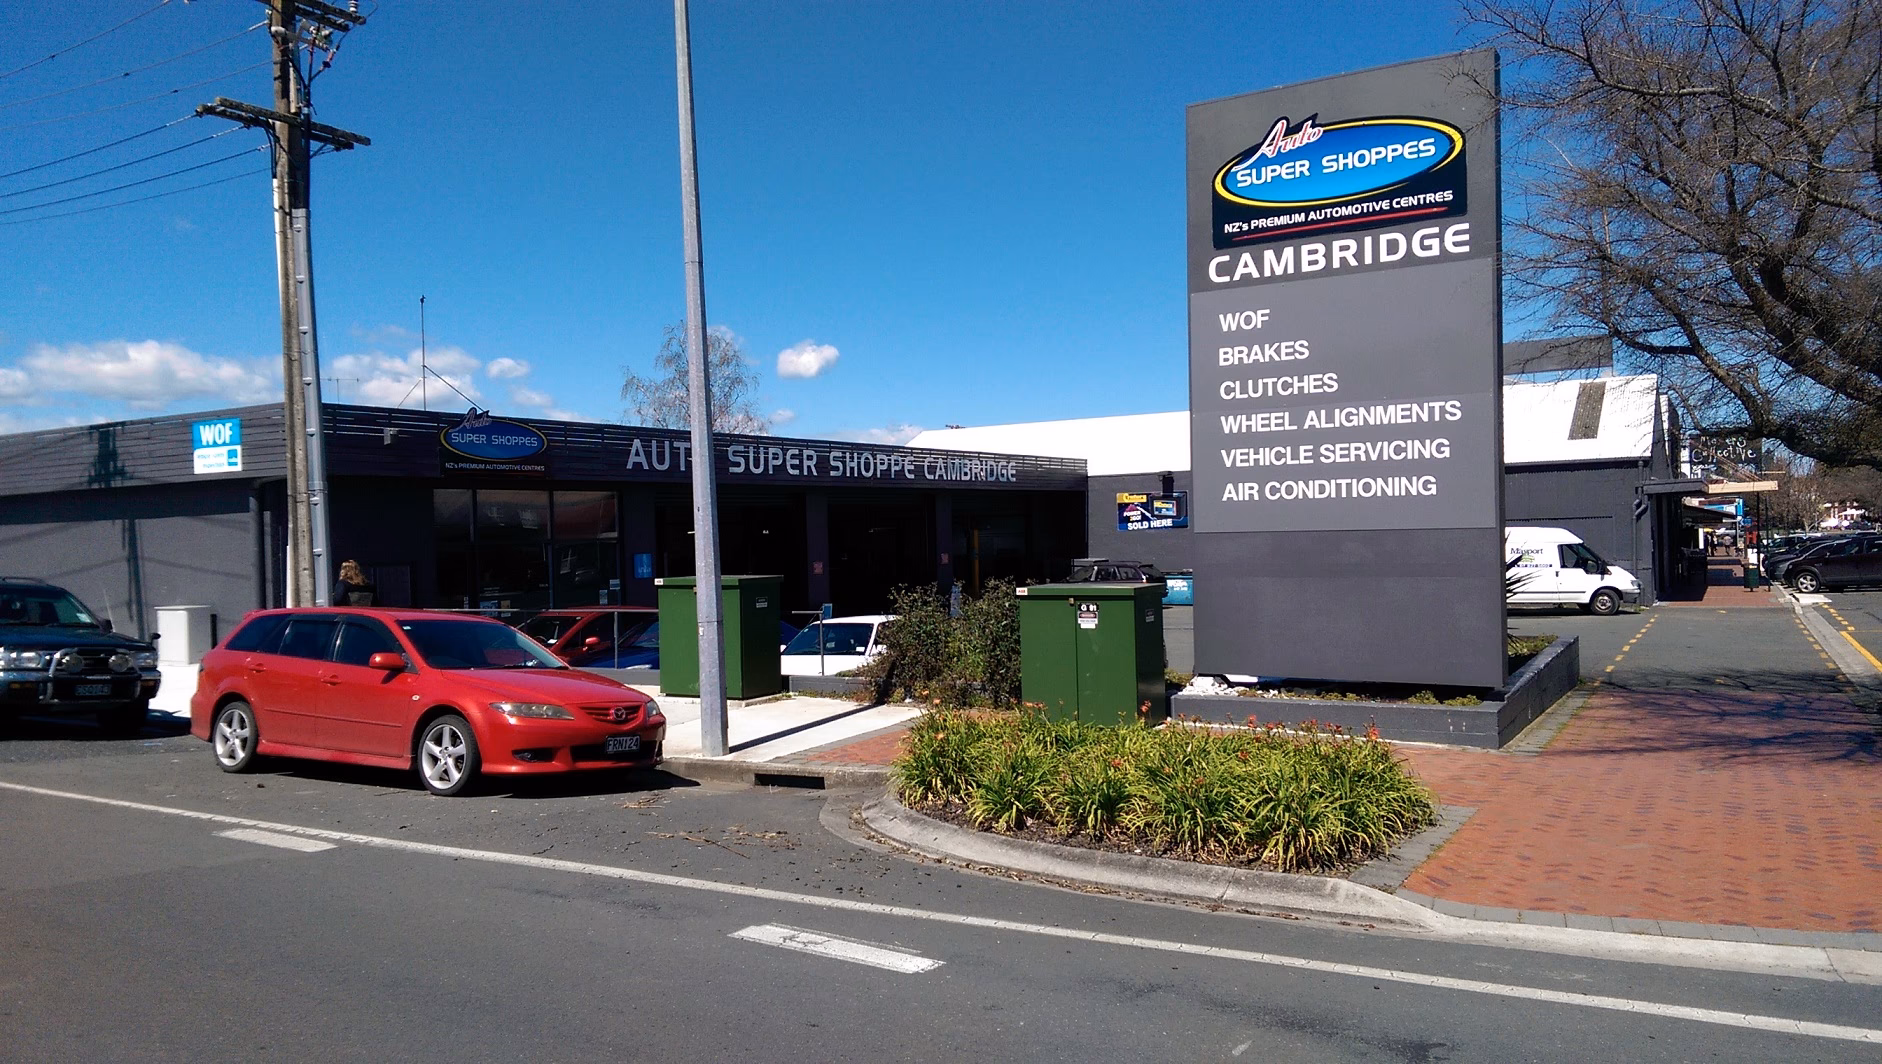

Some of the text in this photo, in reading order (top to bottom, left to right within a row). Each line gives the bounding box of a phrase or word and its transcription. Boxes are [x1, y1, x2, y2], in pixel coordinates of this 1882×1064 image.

[1231, 119, 1324, 173] Auto
[1236, 138, 1436, 187] SUPER SHOPPES
[1224, 190, 1453, 234] NZ's PREMIUM AUTOMOTIVE CENTRES
[1208, 223, 1471, 283] CAMBRIDGE
[1218, 309, 1271, 332] WOF
[1218, 340, 1310, 366] BRAKES
[1219, 373, 1338, 400] CLUTCHES
[449, 408, 492, 432] Auto
[1220, 400, 1462, 434] WHEEL ALIGNMENTS
[199, 422, 233, 446] WOF
[451, 433, 538, 447] SUPER SHOPPES
[626, 439, 1017, 482] AUT SUPER SHOPPE CAMBRIDGE
[1221, 438, 1451, 468] VEHICLE SERVICING
[1222, 476, 1438, 501] AIR CONDITIONING
[1127, 519, 1173, 531] SOLD HERE
